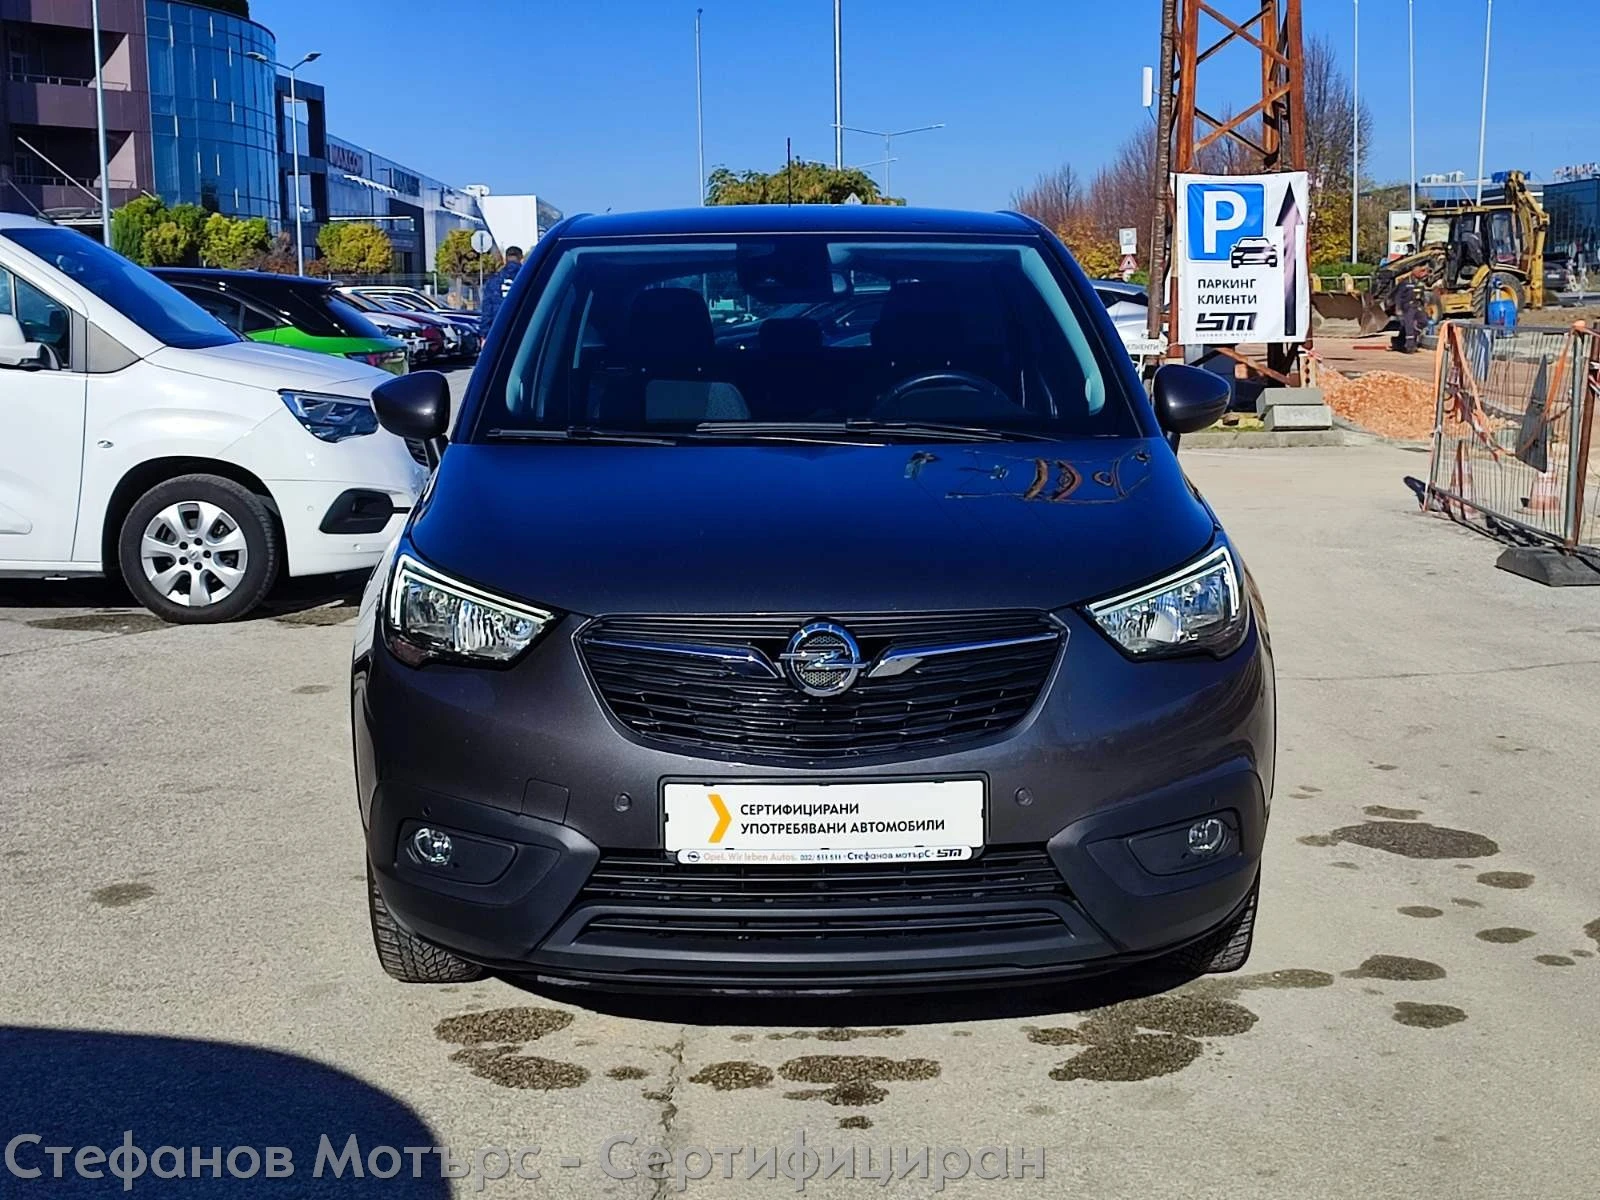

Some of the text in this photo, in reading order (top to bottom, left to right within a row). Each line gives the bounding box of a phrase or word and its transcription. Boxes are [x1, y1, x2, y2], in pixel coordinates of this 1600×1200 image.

[1203, 190, 1248, 254] P
[1197, 278, 1257, 289] ПАРКИНГ
[1197, 294, 1257, 305] КЛИЕНТИ
[740, 803, 859, 817] СЕРТИФИЦИРАНИ
[740, 819, 945, 835] УПОТРЕБЯВАНИ АВТОМОБИЛИ
